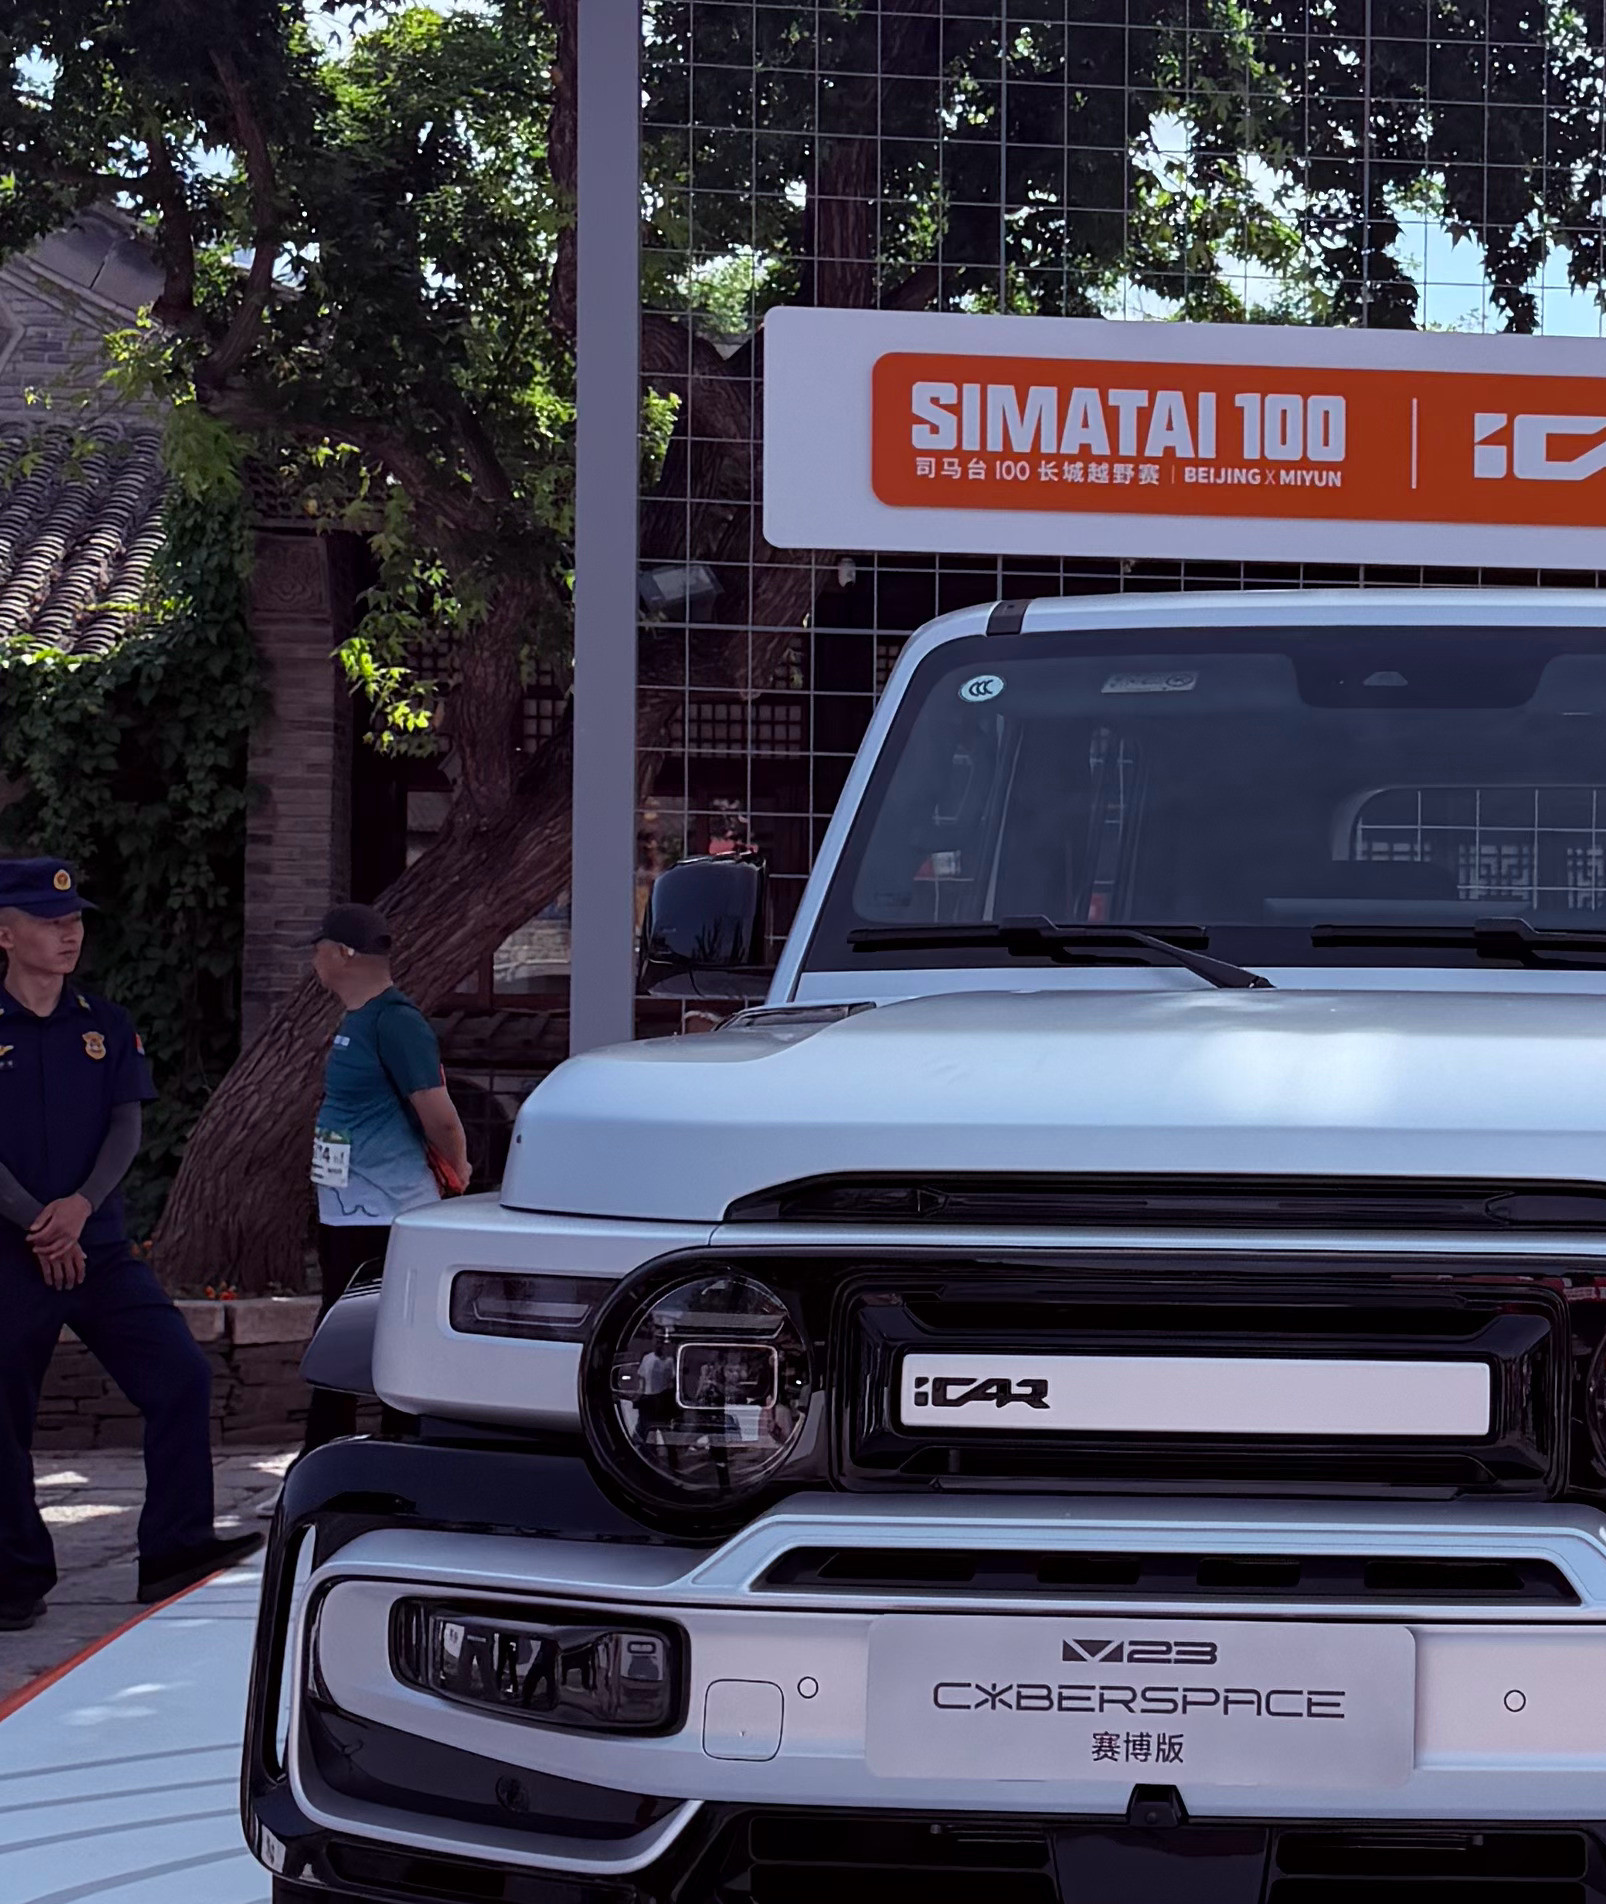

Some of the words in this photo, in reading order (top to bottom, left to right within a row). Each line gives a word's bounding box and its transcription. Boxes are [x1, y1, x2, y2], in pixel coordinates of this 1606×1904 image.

[911, 381, 1216, 459] SIMATAI
[1234, 392, 1347, 462] 100
[915, 456, 988, 481] 司马台
[1037, 459, 1161, 486] 长城越野赛
[1183, 465, 1262, 486] BEIJING
[1279, 468, 1342, 488] MIYUN
[1090, 1730, 1185, 1764] 赛博版
